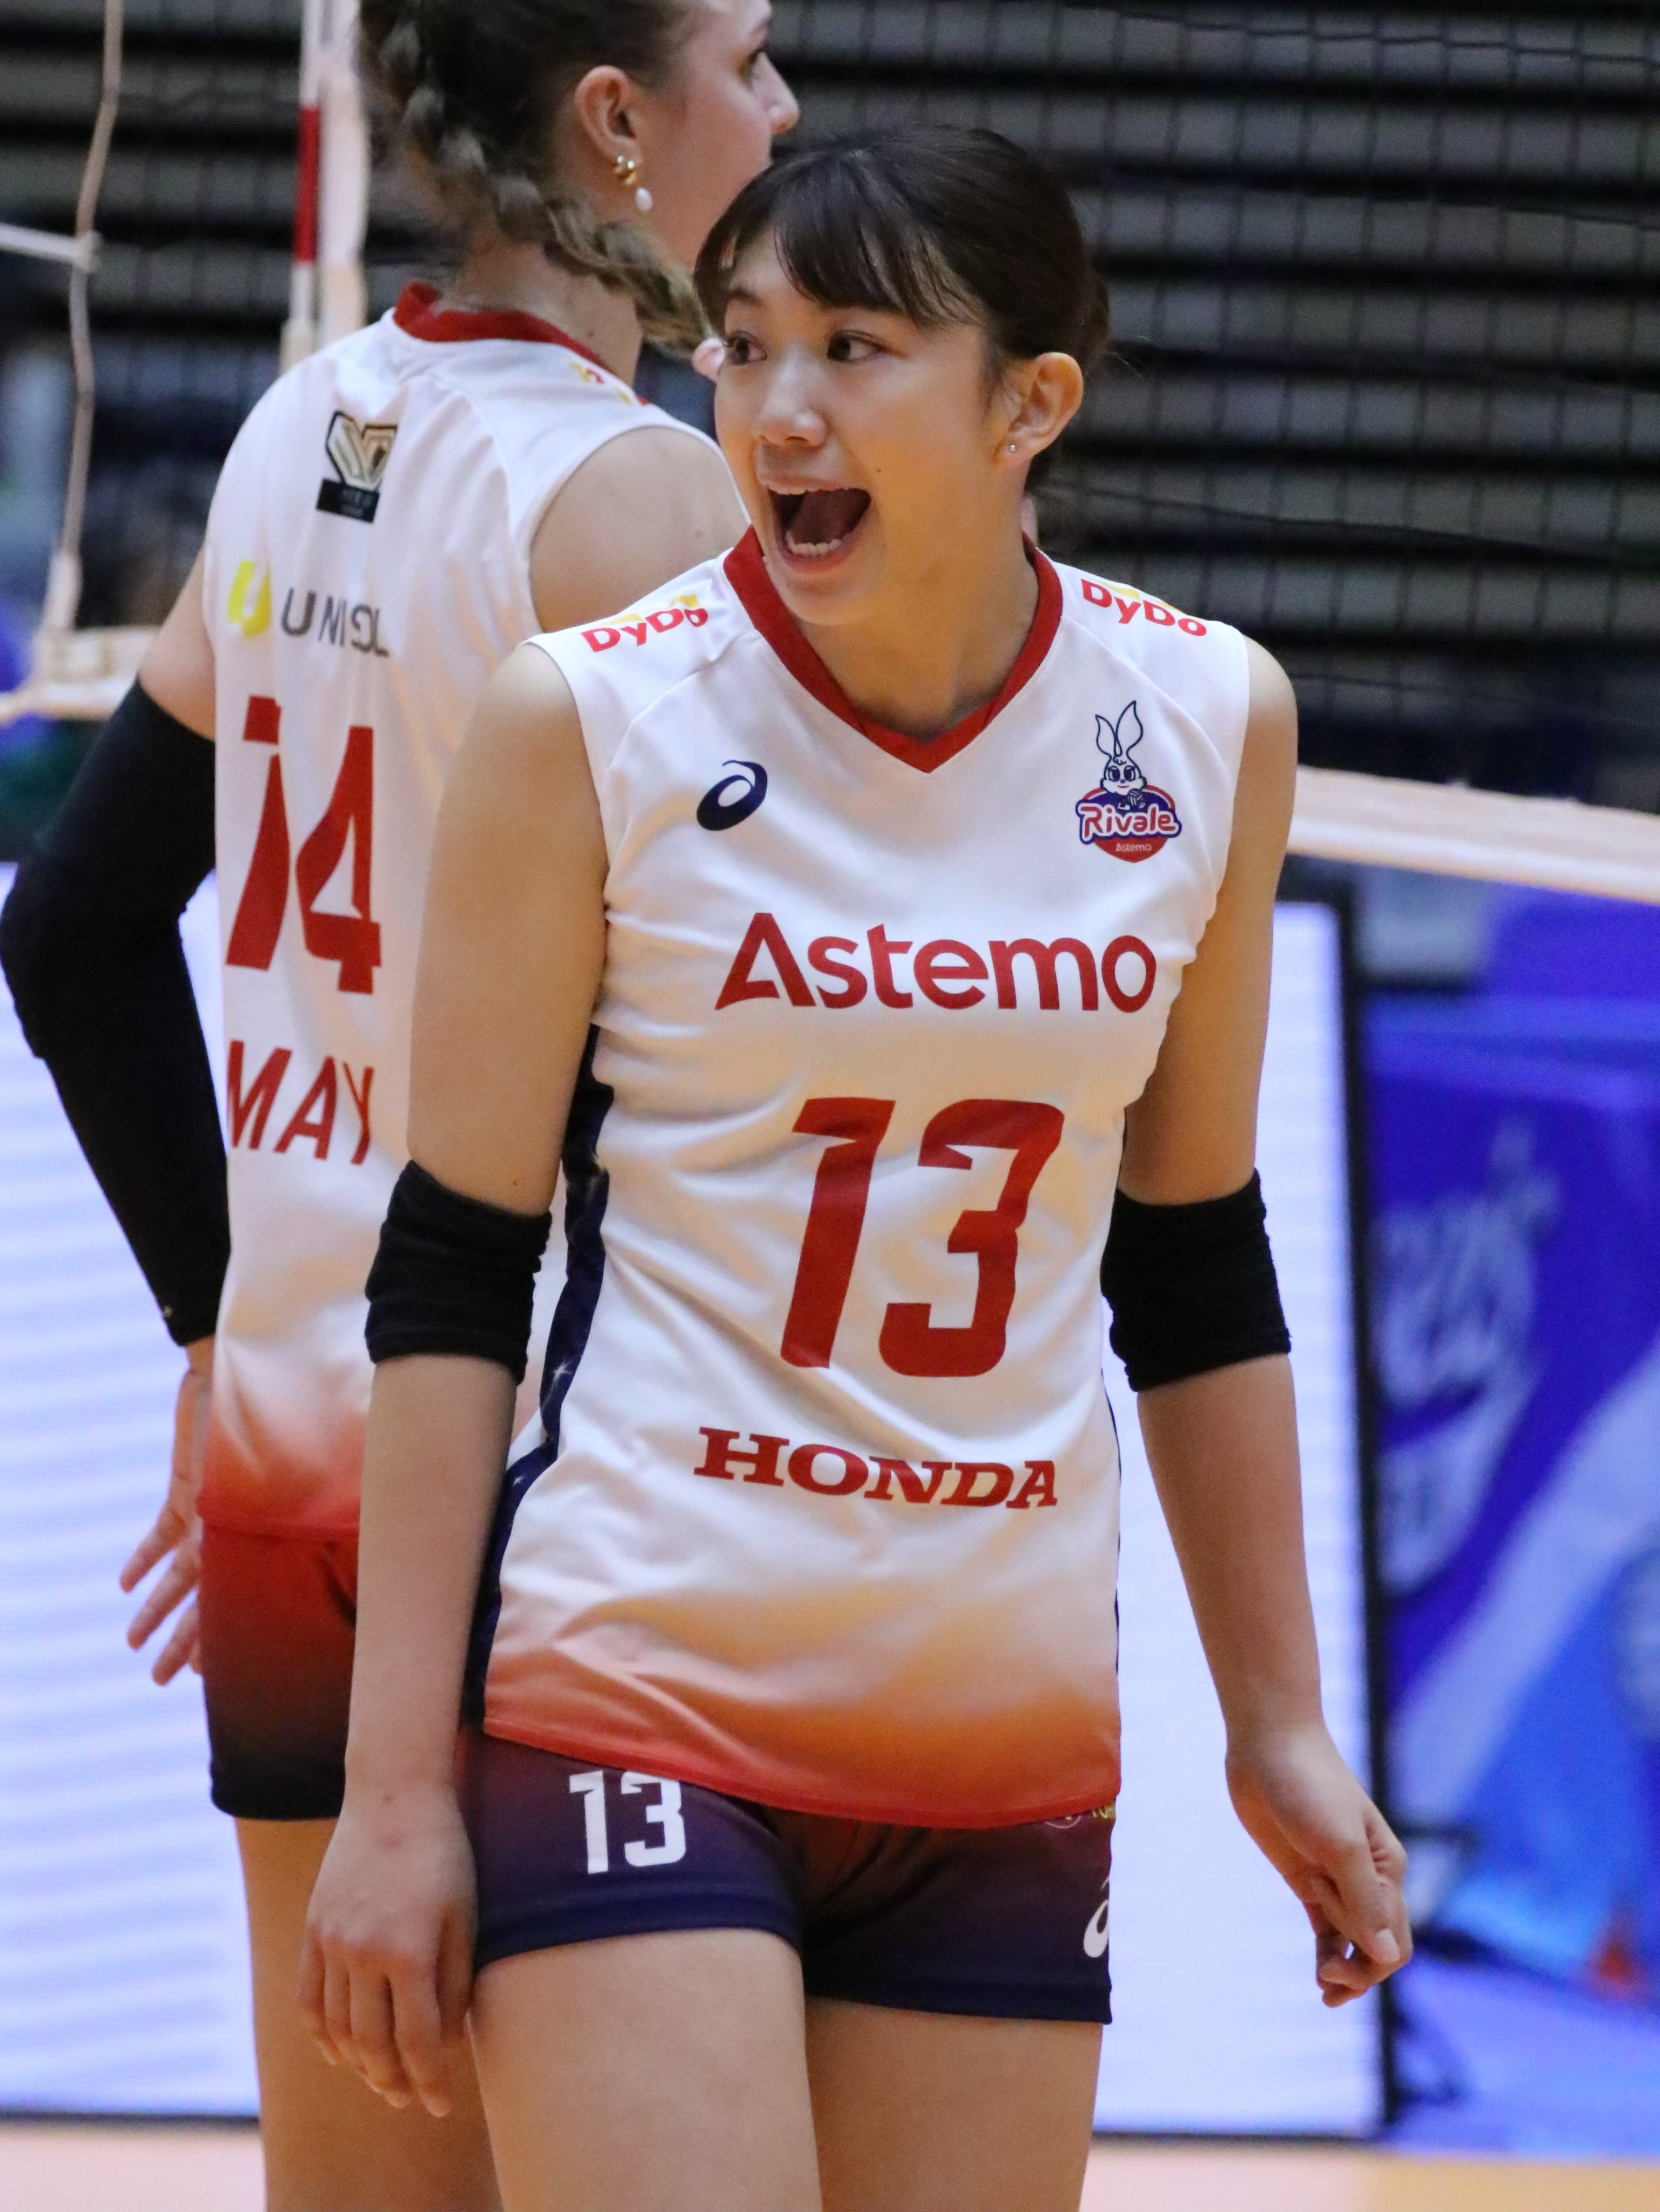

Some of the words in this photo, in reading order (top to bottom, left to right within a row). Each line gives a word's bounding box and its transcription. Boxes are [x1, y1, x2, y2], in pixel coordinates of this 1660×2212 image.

[581, 608, 708, 652] DyDo
[1081, 578, 1207, 637] DyDo
[226, 694, 382, 995] 14
[1081, 806, 1176, 838] Rivale
[1115, 843, 1152, 852] Astemo
[715, 913, 1157, 1014] Astemo
[227, 1040, 375, 1165] MAY
[779, 1096, 1066, 1378] 13
[693, 1427, 1058, 1510] HONDA
[569, 1770, 687, 1874] 13
